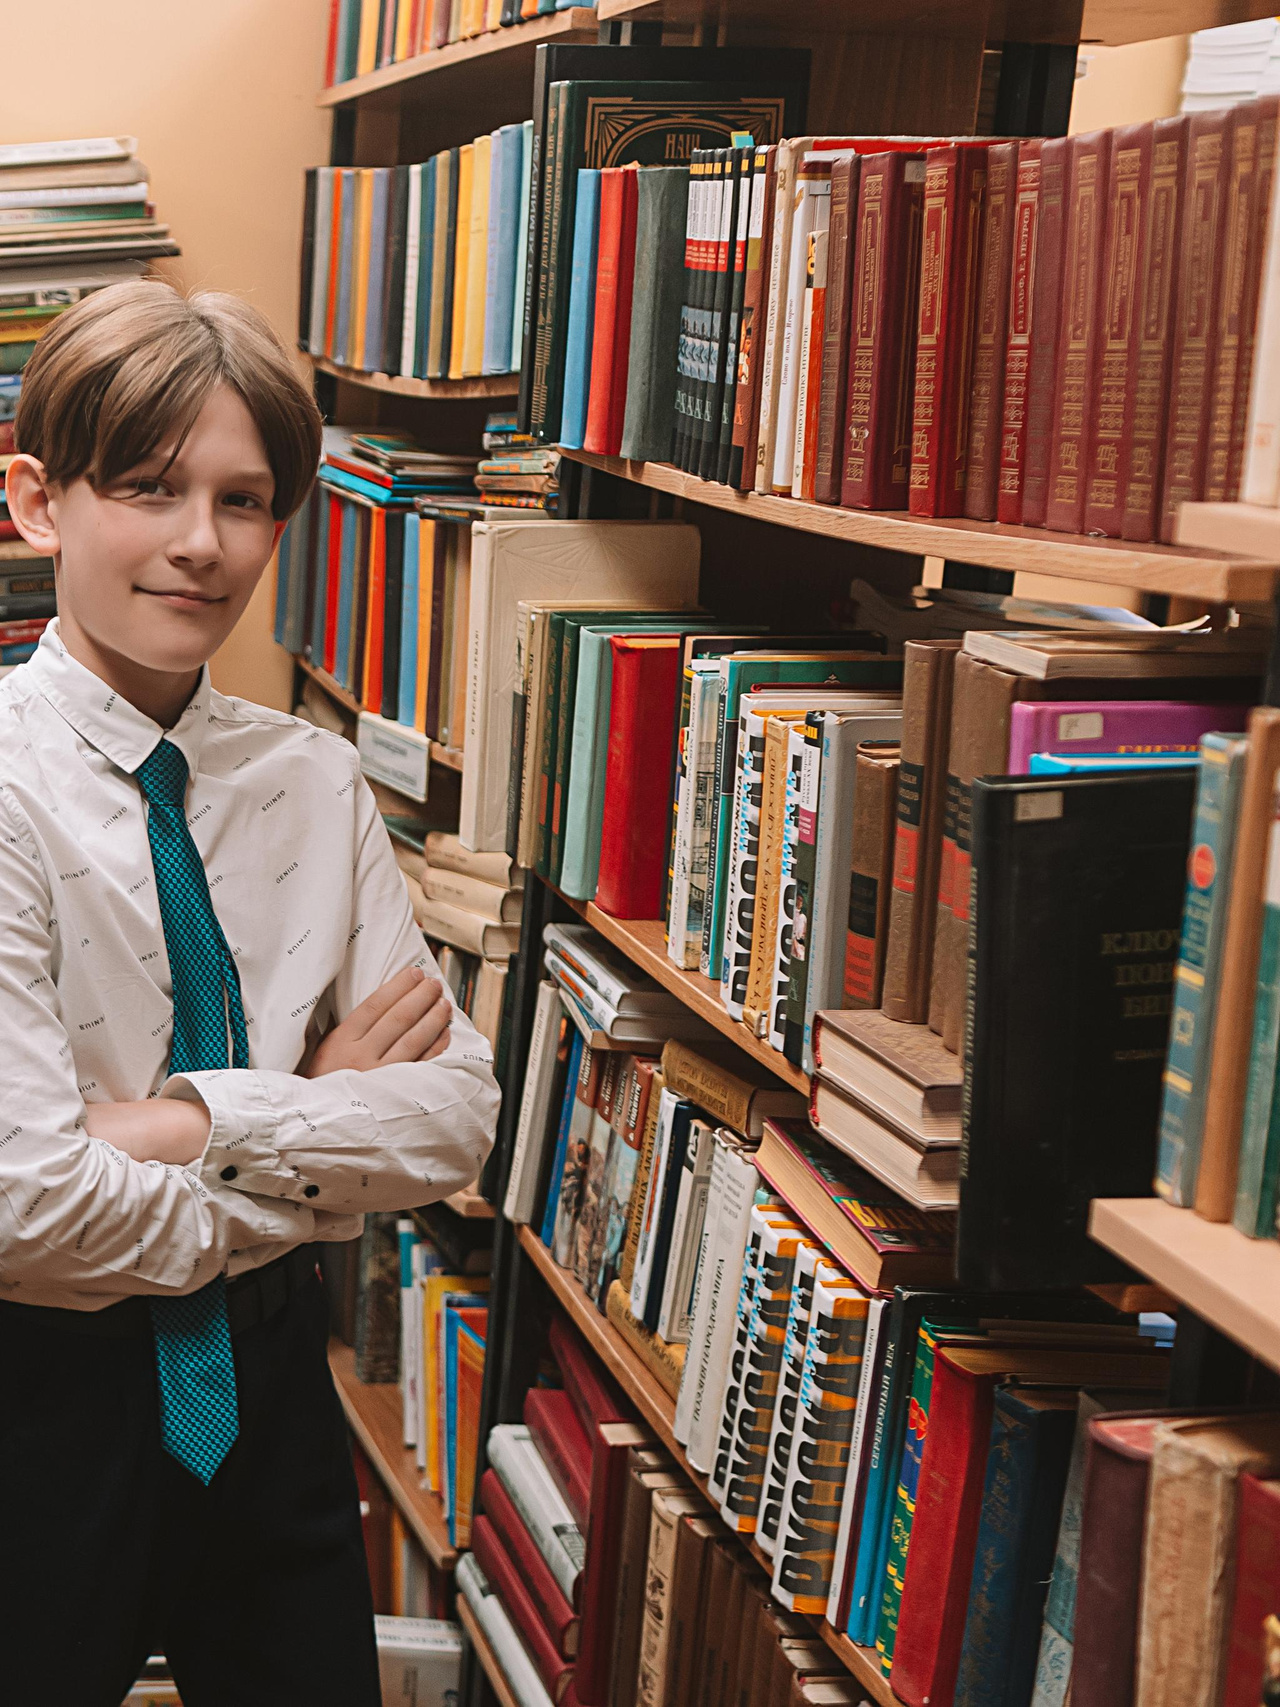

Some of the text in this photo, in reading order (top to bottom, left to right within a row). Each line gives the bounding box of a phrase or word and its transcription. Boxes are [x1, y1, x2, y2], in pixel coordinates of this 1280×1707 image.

[527, 134, 541, 254] ХЕМИНГУЭЙ
[1019, 207, 1031, 258] ПЕТРОВ
[801, 324, 809, 371] ИГОРЕВЕ
[799, 372, 807, 407] ПОЛКУ
[796, 418, 804, 453] СЛОВО
[101, 806, 128, 830] GENIUS
[261, 789, 286, 813] GENIUS
[59, 867, 91, 881] GENIUS
[275, 861, 299, 885] GENIUS
[286, 928, 312, 956] GENIUS
[290, 995, 320, 1018] GENIUS
[24, 1187, 50, 1217] GENIUS
[700, 1297, 719, 1366] НАРОДОВ
[711, 1258, 726, 1298] МИРА
[870, 1340, 896, 1469] СЕРЕБРЯНЫЙ ВЕК
[777, 1311, 869, 1598] РУССКАЯ
